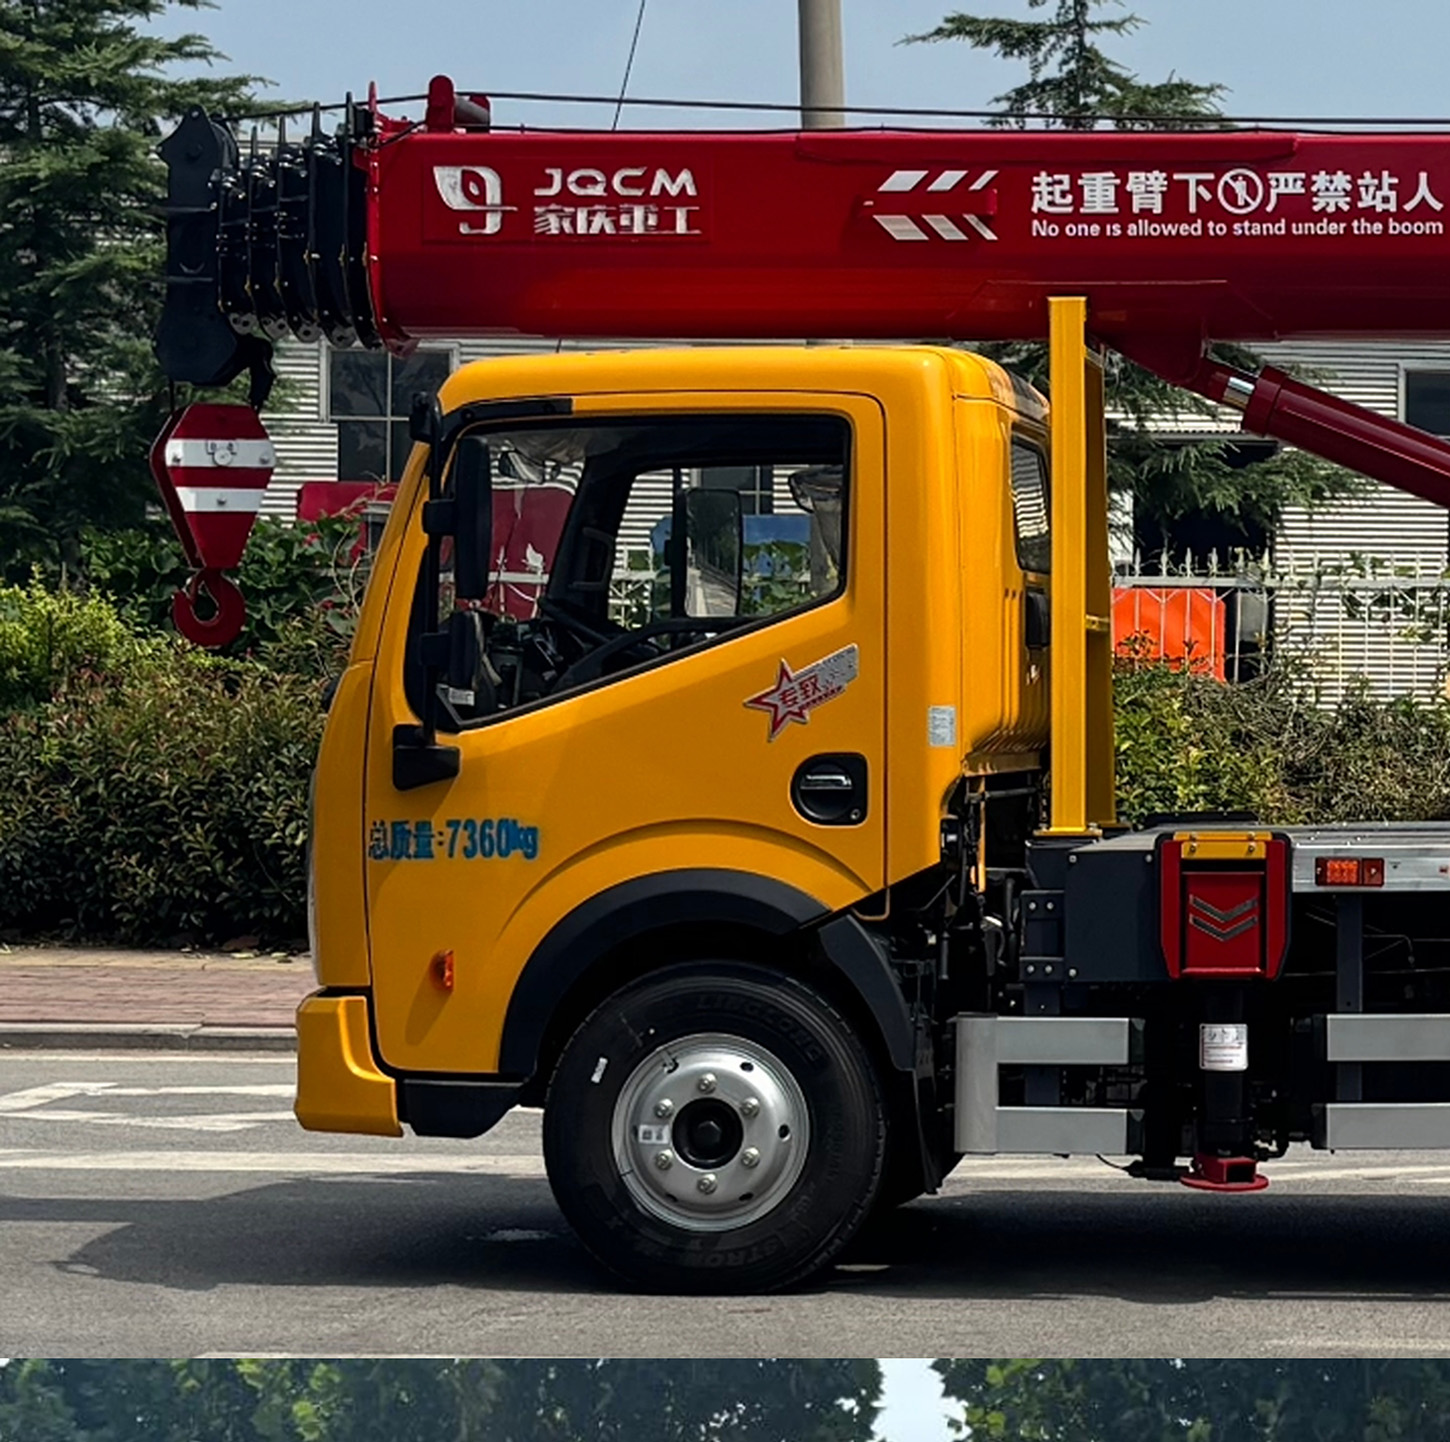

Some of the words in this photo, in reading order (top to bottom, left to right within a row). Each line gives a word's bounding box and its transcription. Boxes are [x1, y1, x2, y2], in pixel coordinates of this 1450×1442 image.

[534, 167, 698, 197] JQCM
[1031, 171, 1216, 214] 起重臂下
[1265, 170, 1444, 213] 严禁站人
[1031, 219, 1060, 237] No
[1065, 222, 1101, 237] one
[1106, 220, 1122, 237] is
[1127, 218, 1202, 237] allowed
[1207, 220, 1228, 237] to
[1232, 218, 1286, 236] stand
[1291, 218, 1347, 236] under
[1351, 218, 1384, 236] the
[1388, 218, 1444, 236] boom
